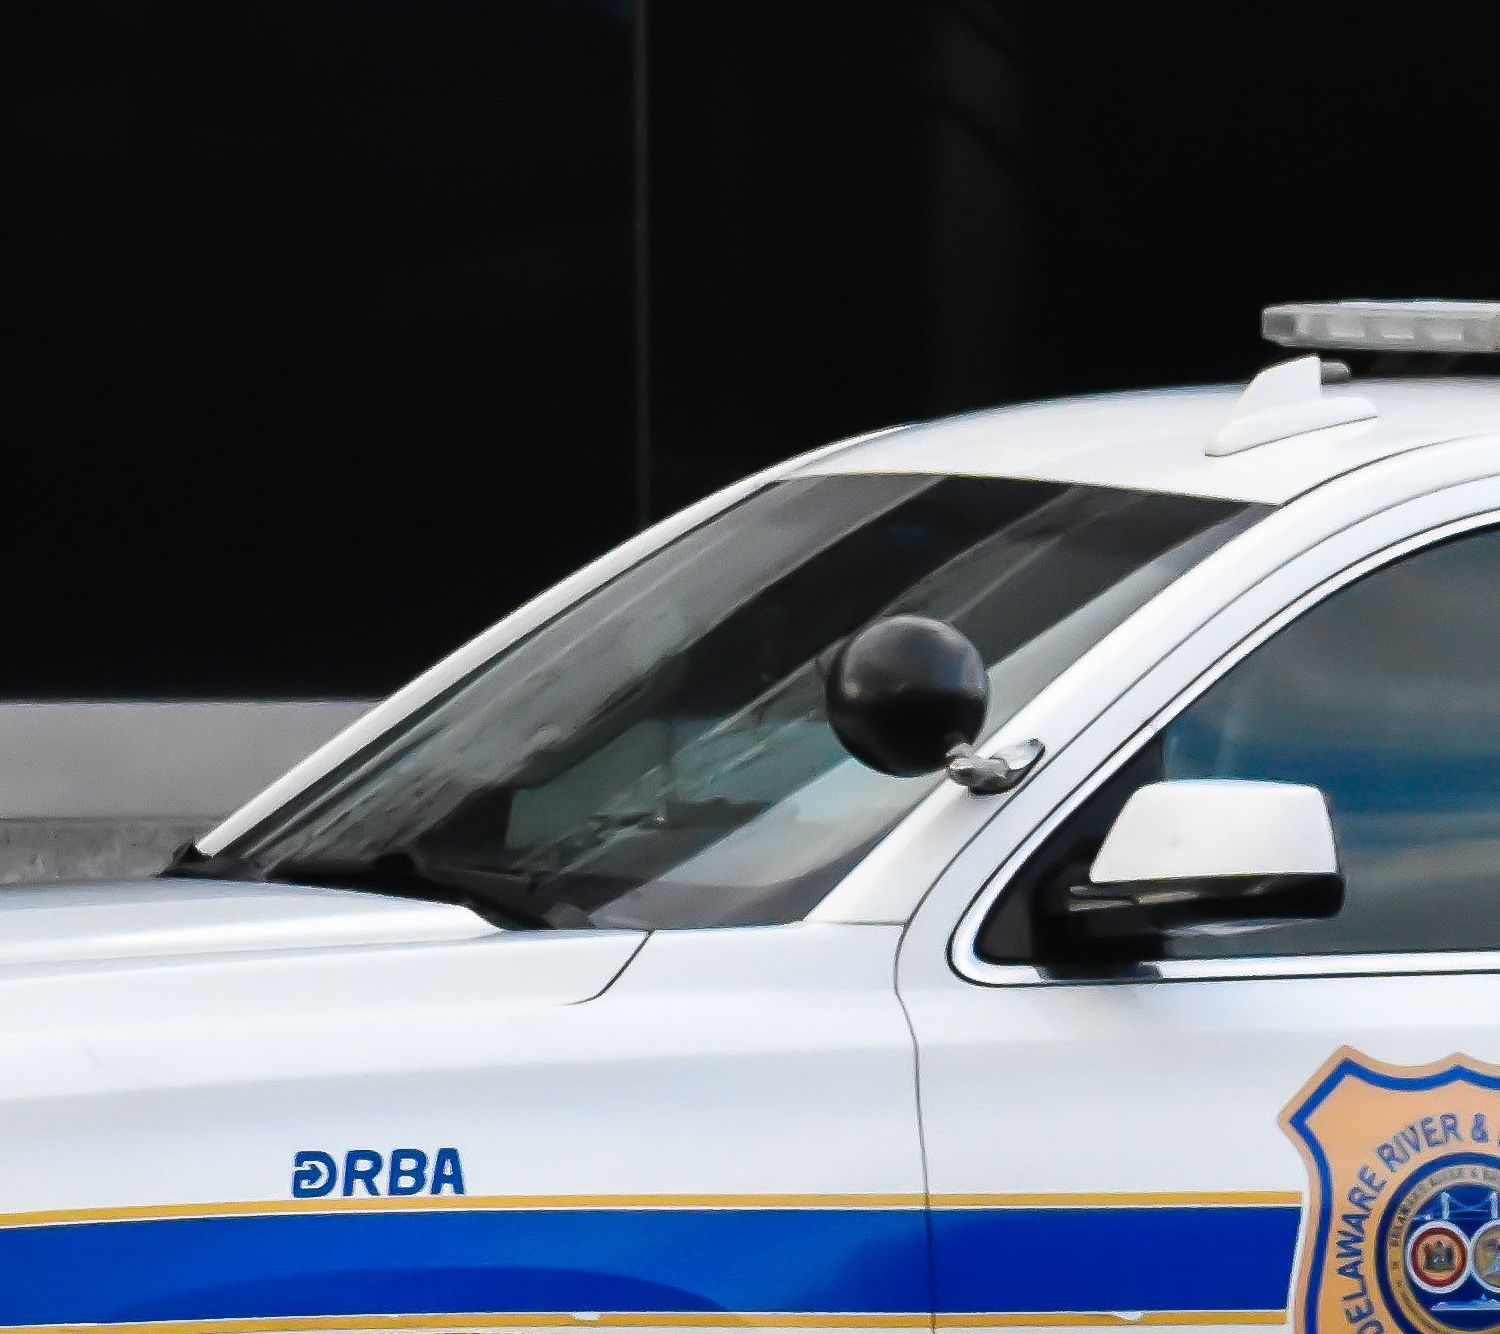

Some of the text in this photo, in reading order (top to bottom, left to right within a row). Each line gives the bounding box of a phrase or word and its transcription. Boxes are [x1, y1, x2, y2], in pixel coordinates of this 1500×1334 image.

[1377, 1113, 1463, 1173] RIVER
[1471, 1112, 1489, 1143] &
[293, 1147, 465, 1198] DRBA
